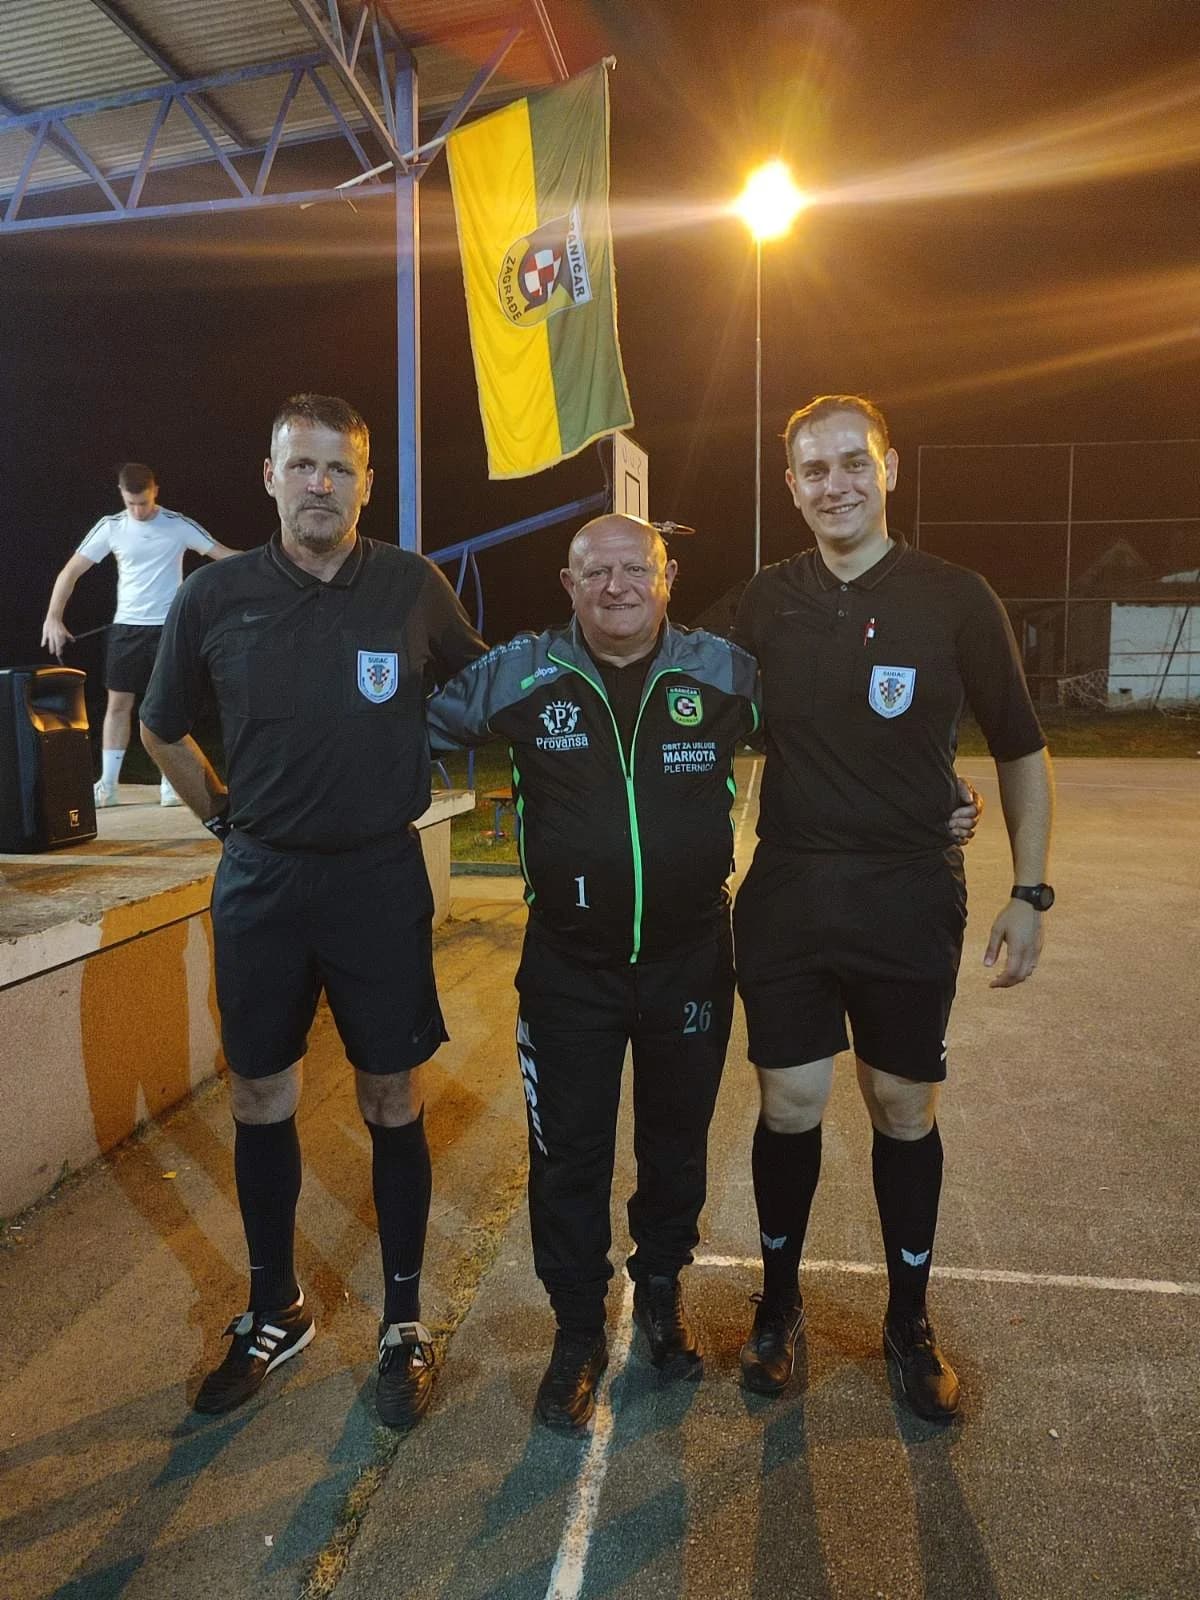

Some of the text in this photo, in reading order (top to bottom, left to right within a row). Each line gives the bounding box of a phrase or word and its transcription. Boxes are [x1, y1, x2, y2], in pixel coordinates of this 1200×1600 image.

[502, 256, 522, 321] ZAGRAĐE
[554, 708, 567, 729] P
[536, 736, 589, 750] Provansa
[662, 743, 681, 751] OBRT
[683, 742, 691, 750] ZA
[663, 750, 716, 763] MARKOTA
[574, 876, 590, 909] 1
[682, 1001, 712, 1034] 26
